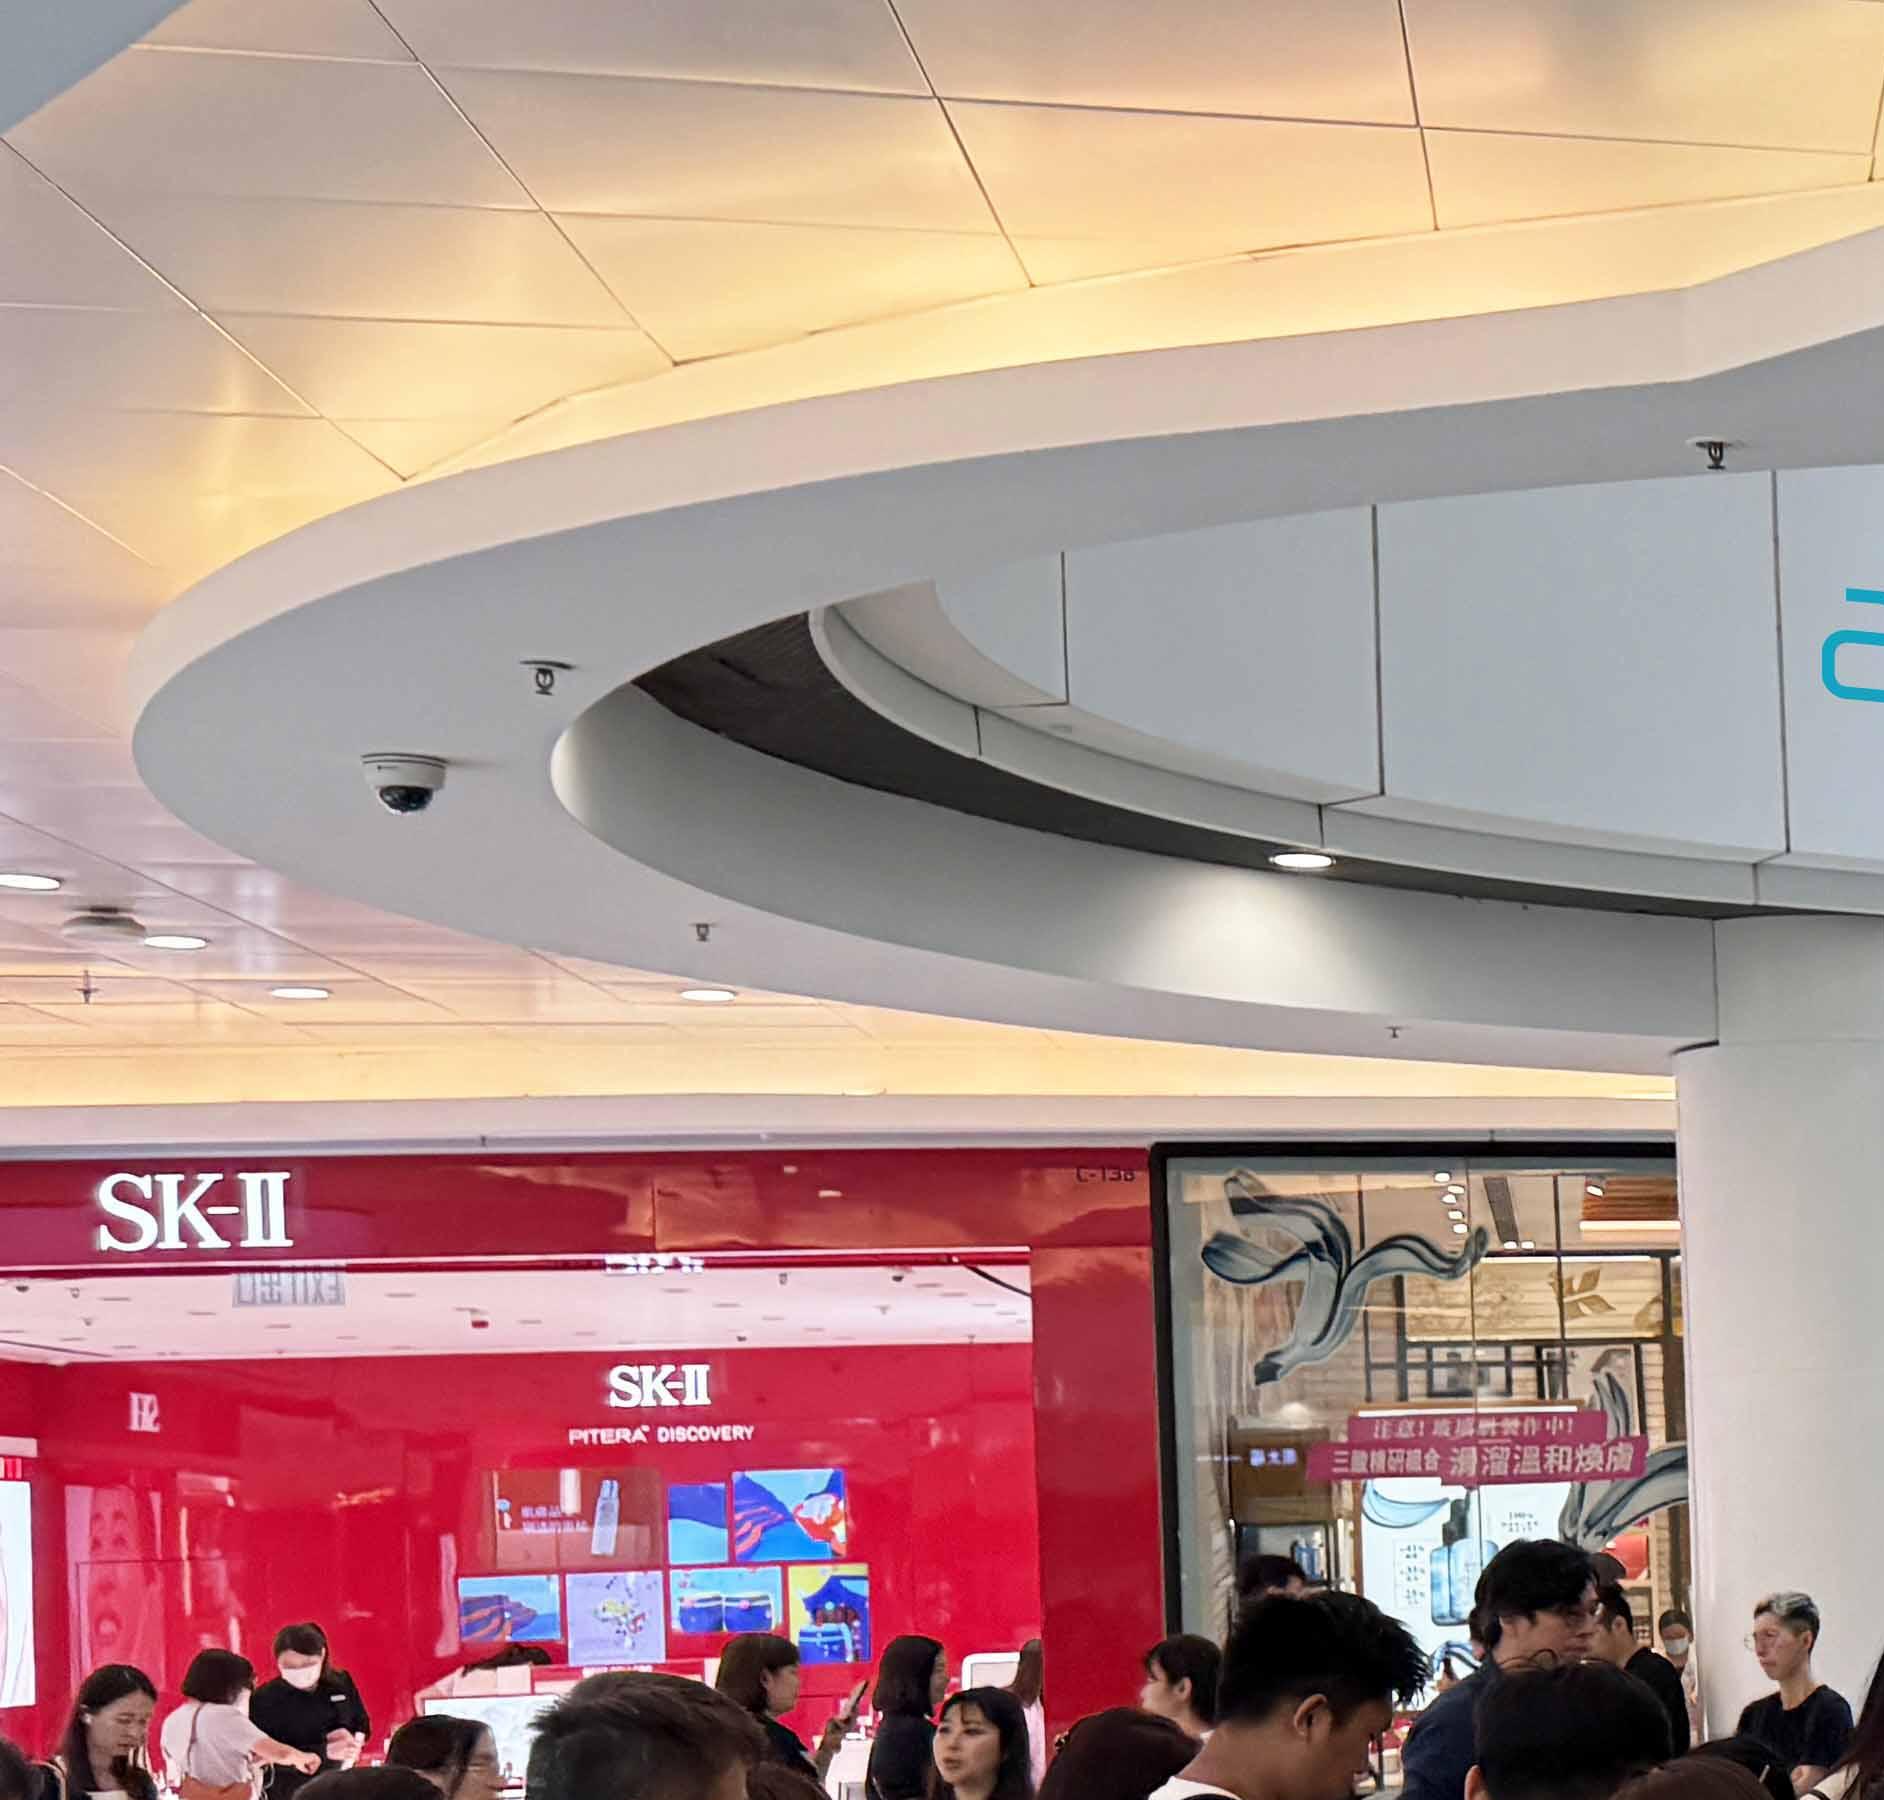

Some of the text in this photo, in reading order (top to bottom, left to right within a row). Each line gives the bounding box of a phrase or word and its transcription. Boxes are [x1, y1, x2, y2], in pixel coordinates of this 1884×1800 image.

[98, 1172, 294, 1252] SK-II
[609, 1364, 712, 1408] SK-II
[656, 1425, 755, 1445] DISCOVERY
